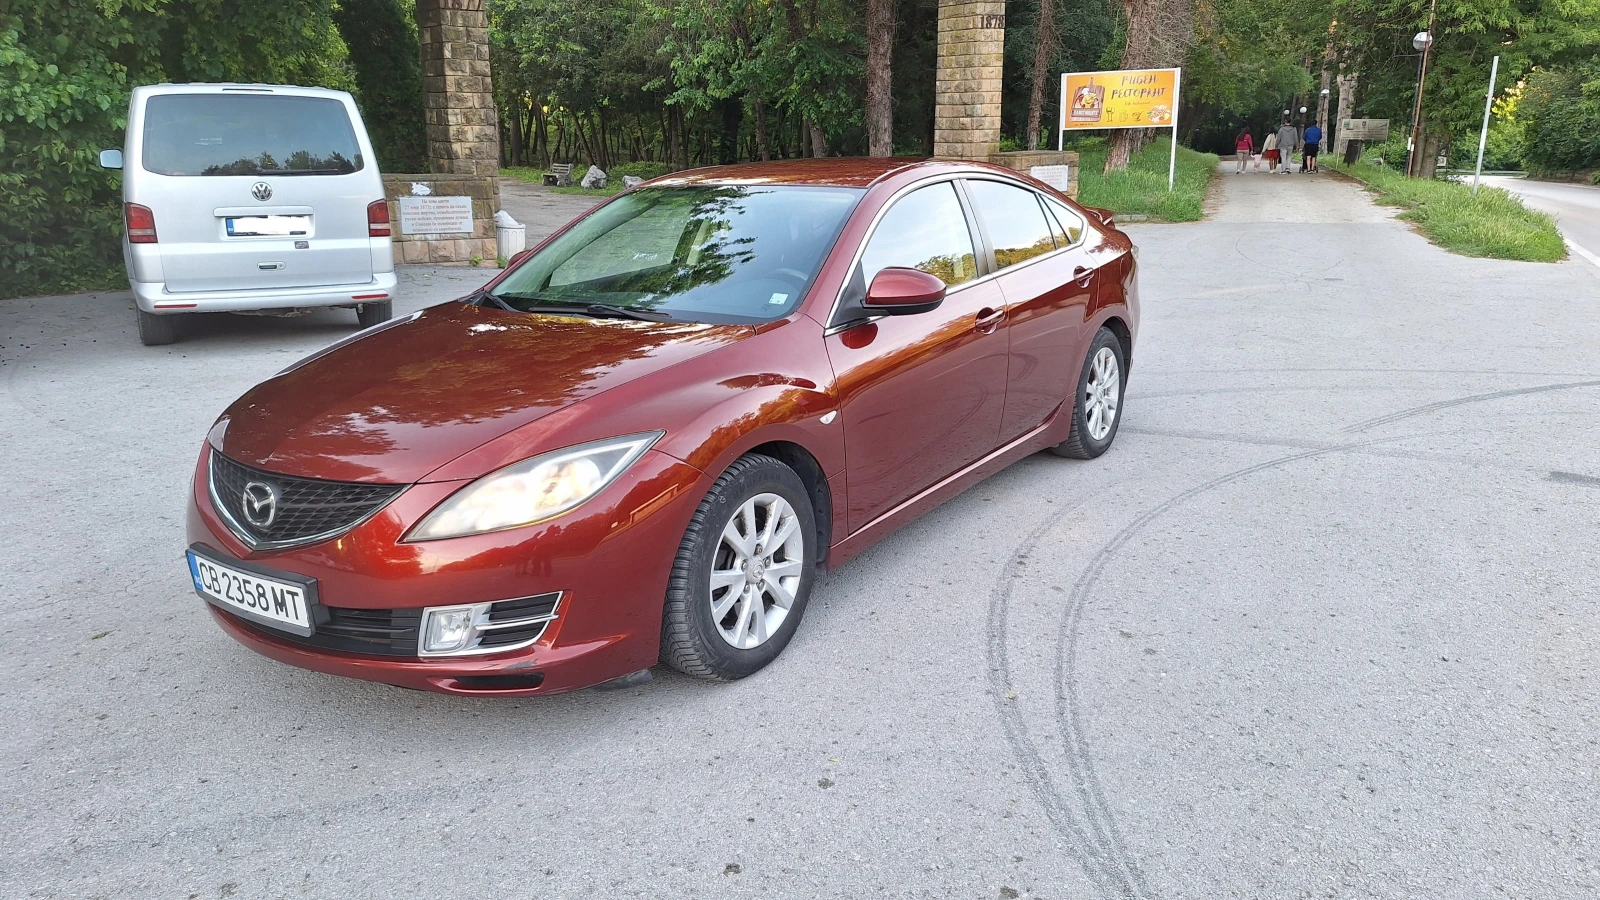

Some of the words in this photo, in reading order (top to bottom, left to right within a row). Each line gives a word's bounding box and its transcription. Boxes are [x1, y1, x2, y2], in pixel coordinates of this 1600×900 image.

[980, 15, 1004, 28] 1878
[199, 562, 222, 595] CB
[222, 572, 270, 612] 2358
[271, 586, 299, 620] MT
